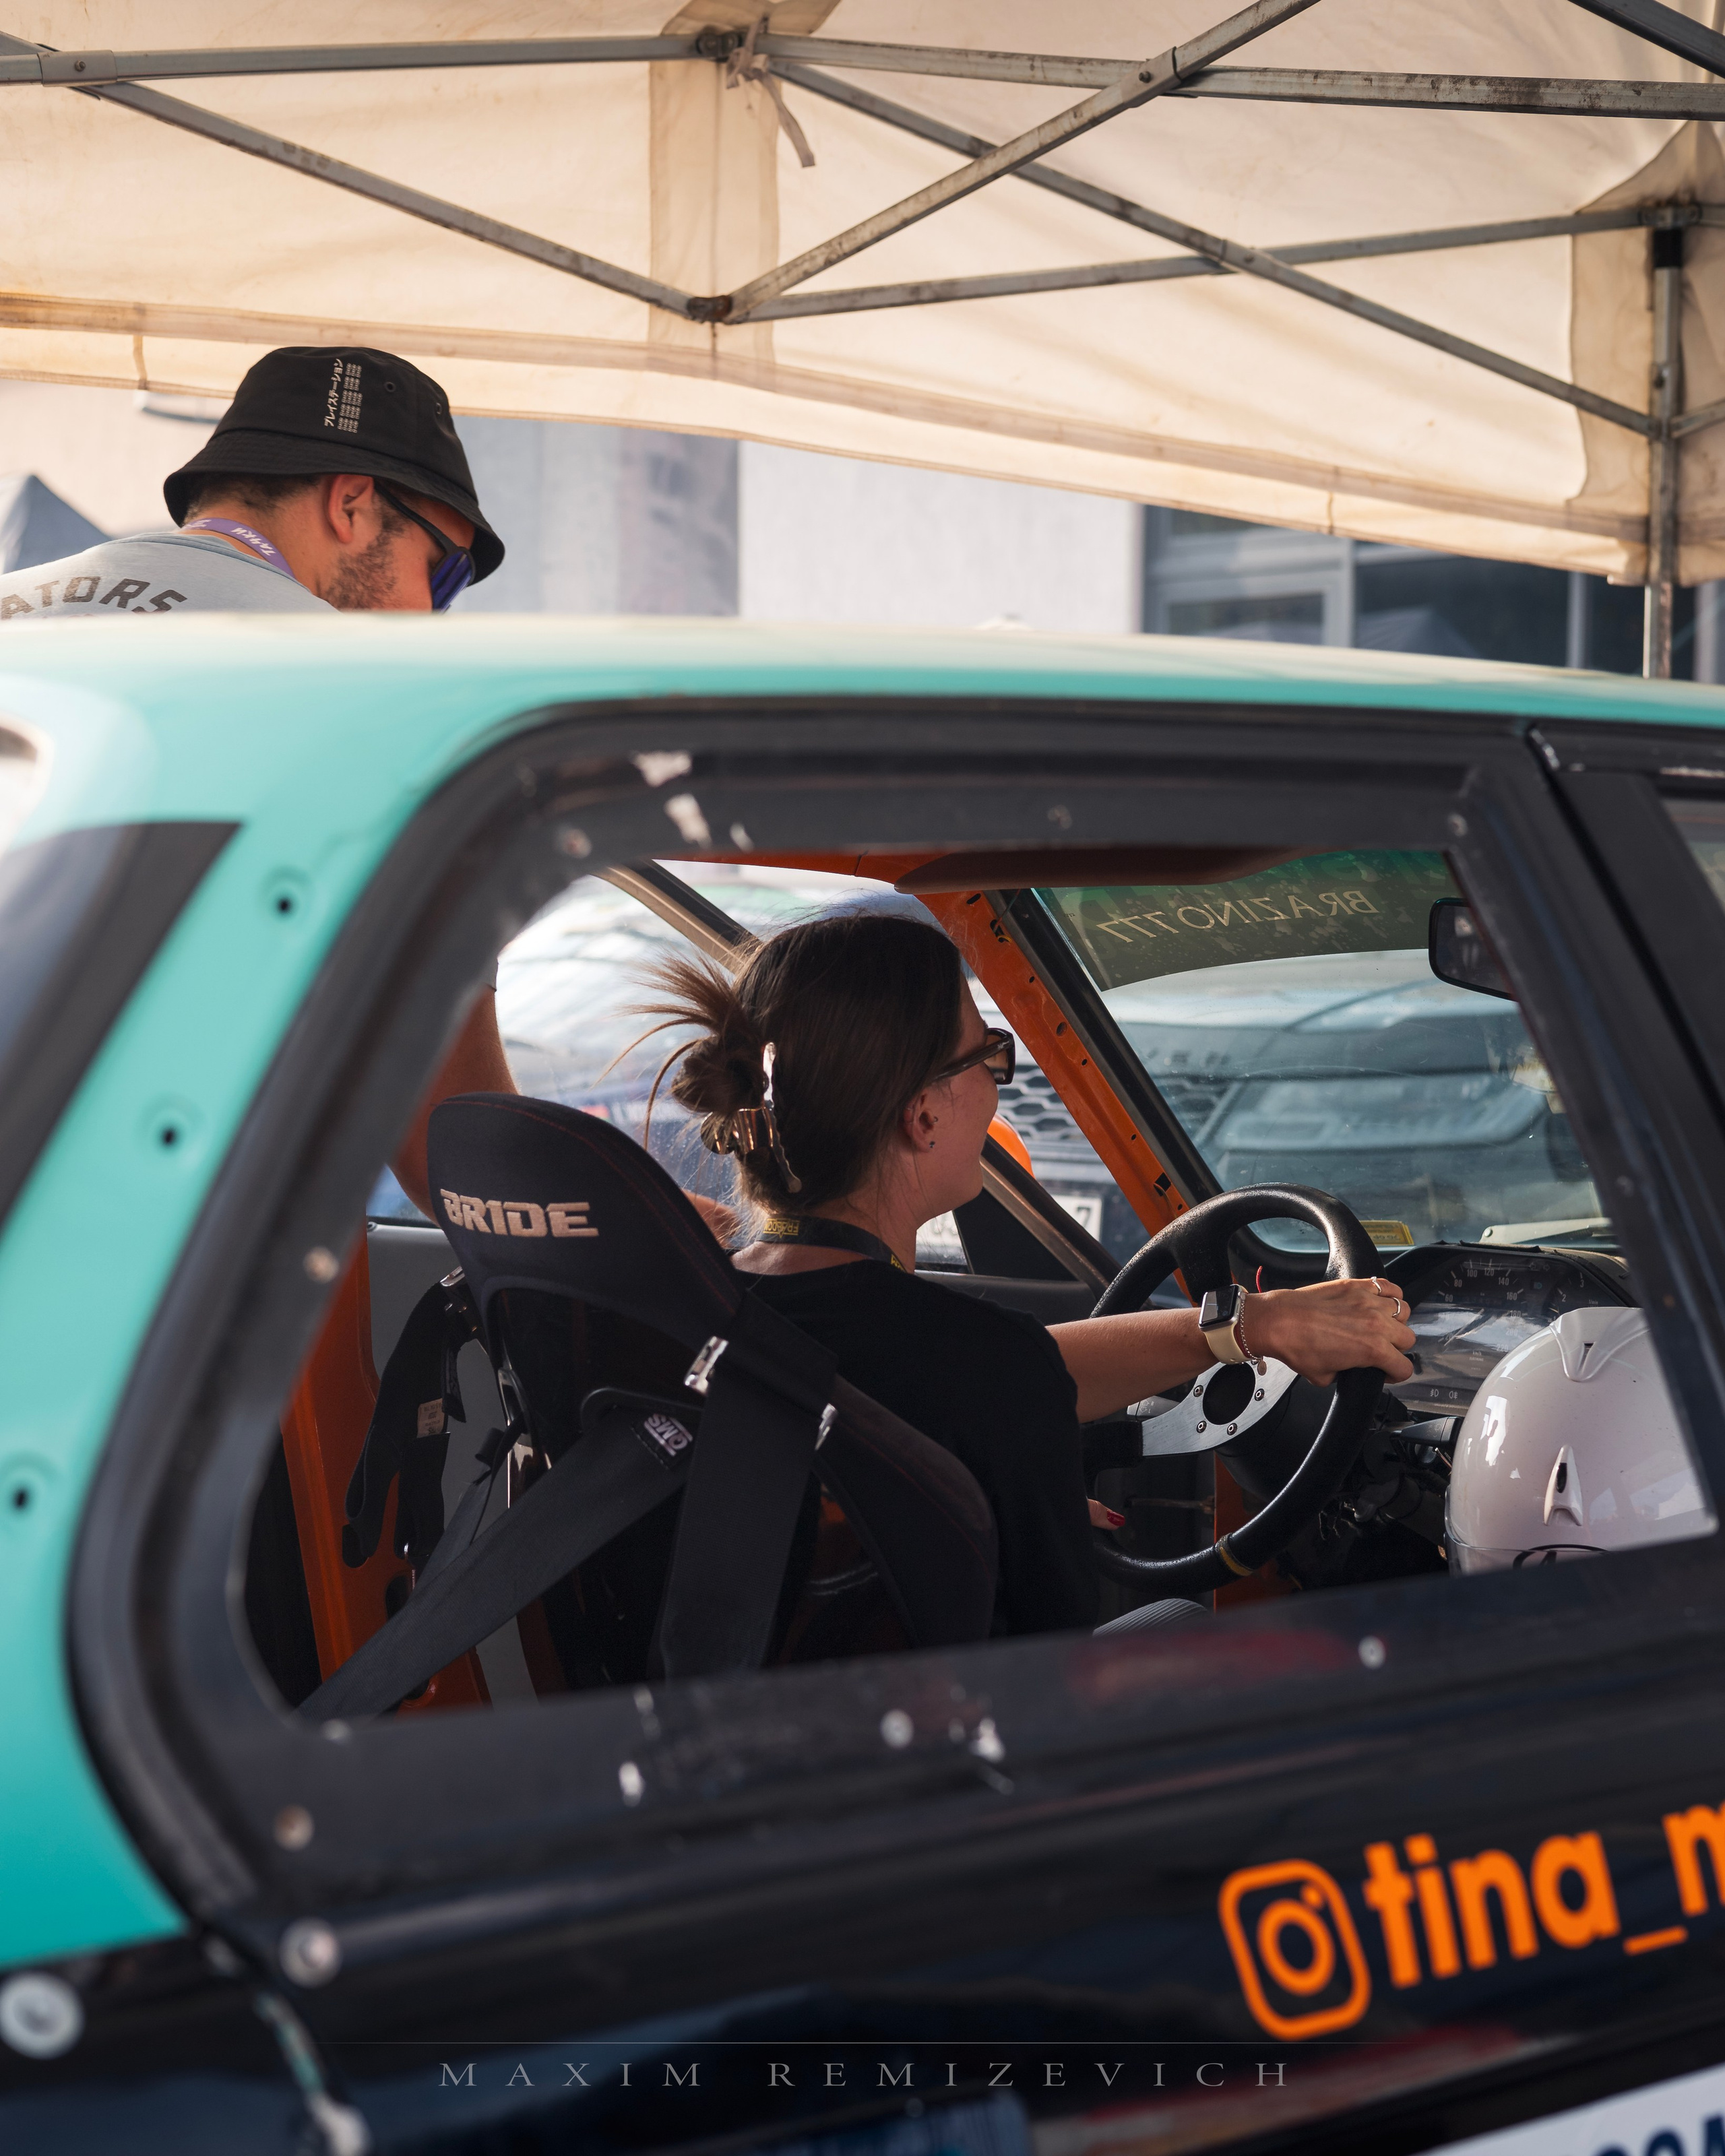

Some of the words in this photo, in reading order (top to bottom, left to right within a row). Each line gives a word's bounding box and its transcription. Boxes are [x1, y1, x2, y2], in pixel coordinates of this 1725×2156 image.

[440, 1188, 599, 1238] BRIDE
[1467, 1269, 1478, 1277] 100
[1484, 1268, 1495, 1276] 120
[1454, 1279, 1462, 1288] 80
[1499, 1277, 1509, 1286] 140
[1580, 1279, 1584, 1288] 3
[1445, 1294, 1453, 1302] 60
[1507, 1292, 1517, 1300] 160
[1509, 1310, 1522, 1318] 180
[1505, 1328, 1518, 1336] 200
[1496, 1344, 1509, 1353] 220
